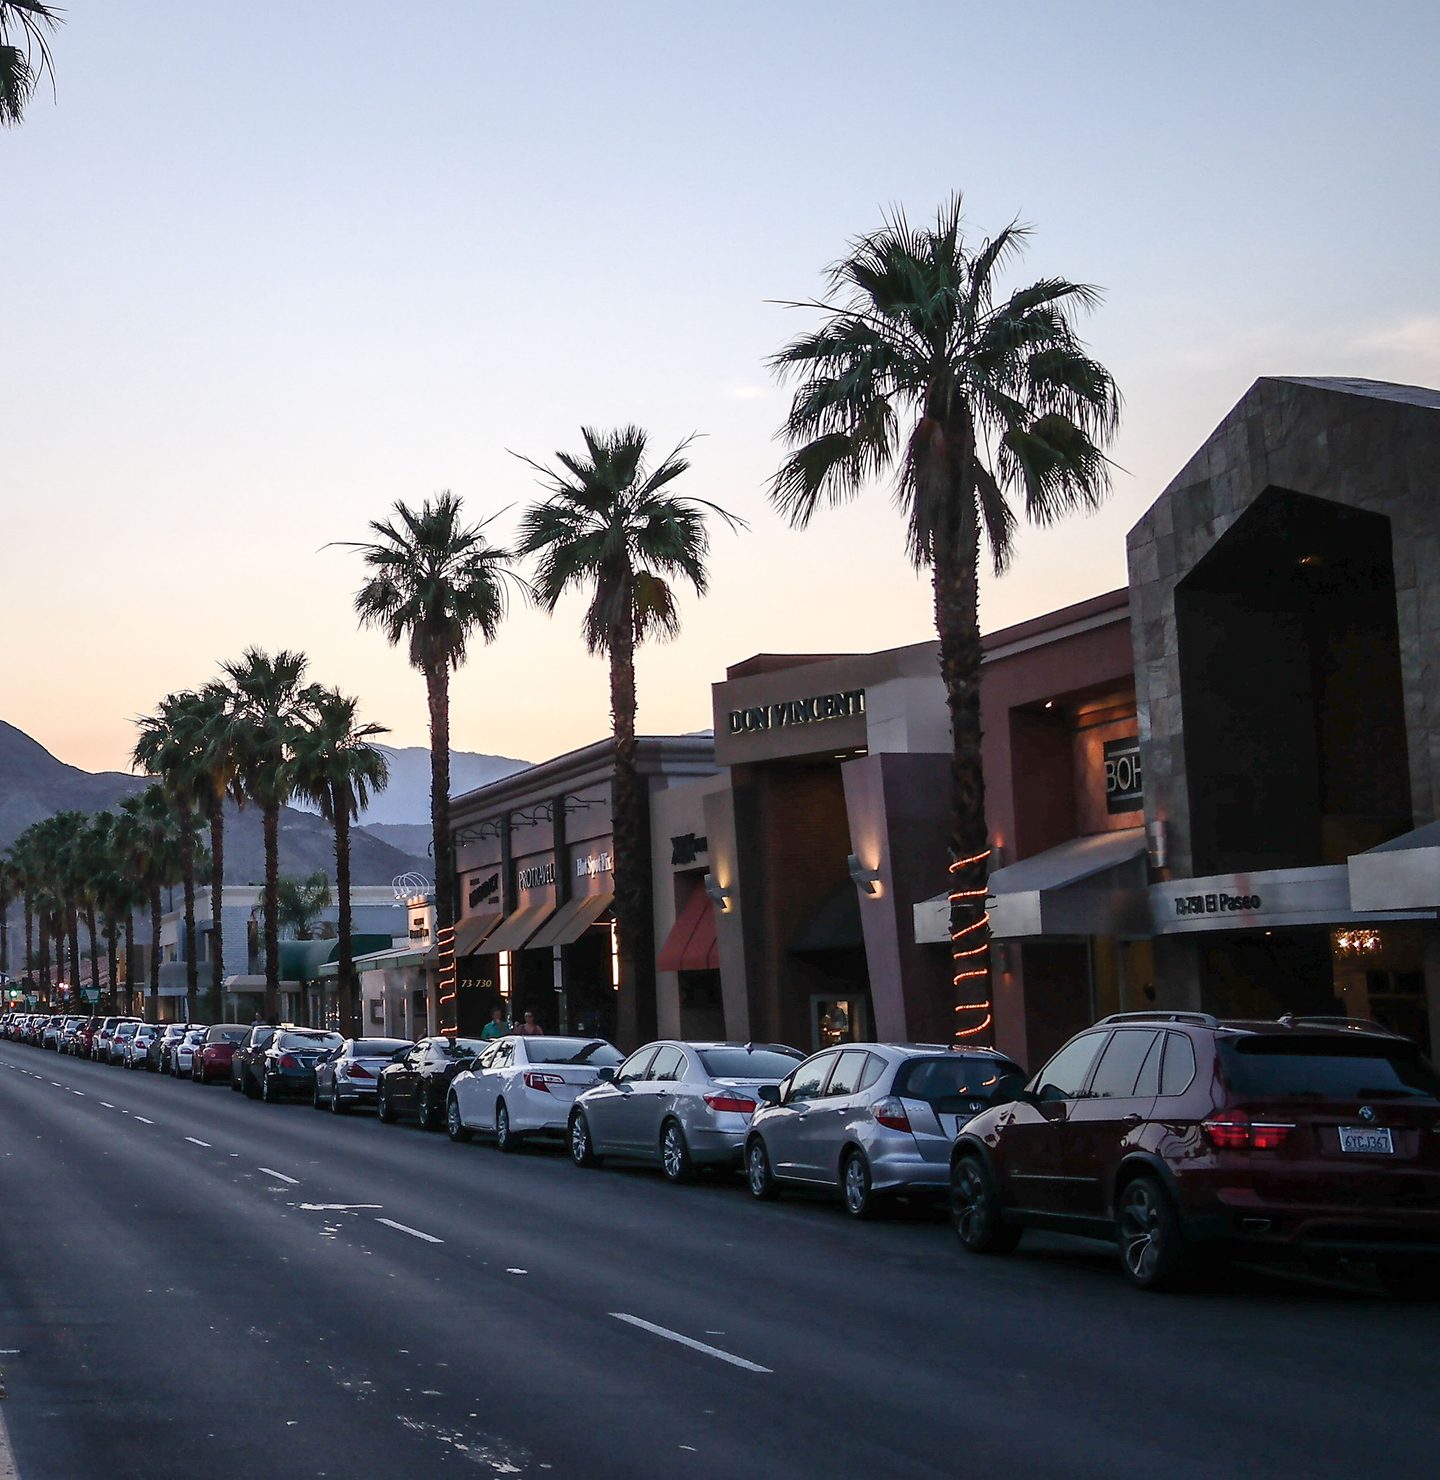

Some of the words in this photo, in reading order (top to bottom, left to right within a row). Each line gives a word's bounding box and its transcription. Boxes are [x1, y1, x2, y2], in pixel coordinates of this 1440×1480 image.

[729, 706, 772, 734] DON
[774, 688, 866, 726] VINCENT
[1219, 893, 1262, 911] Paseo
